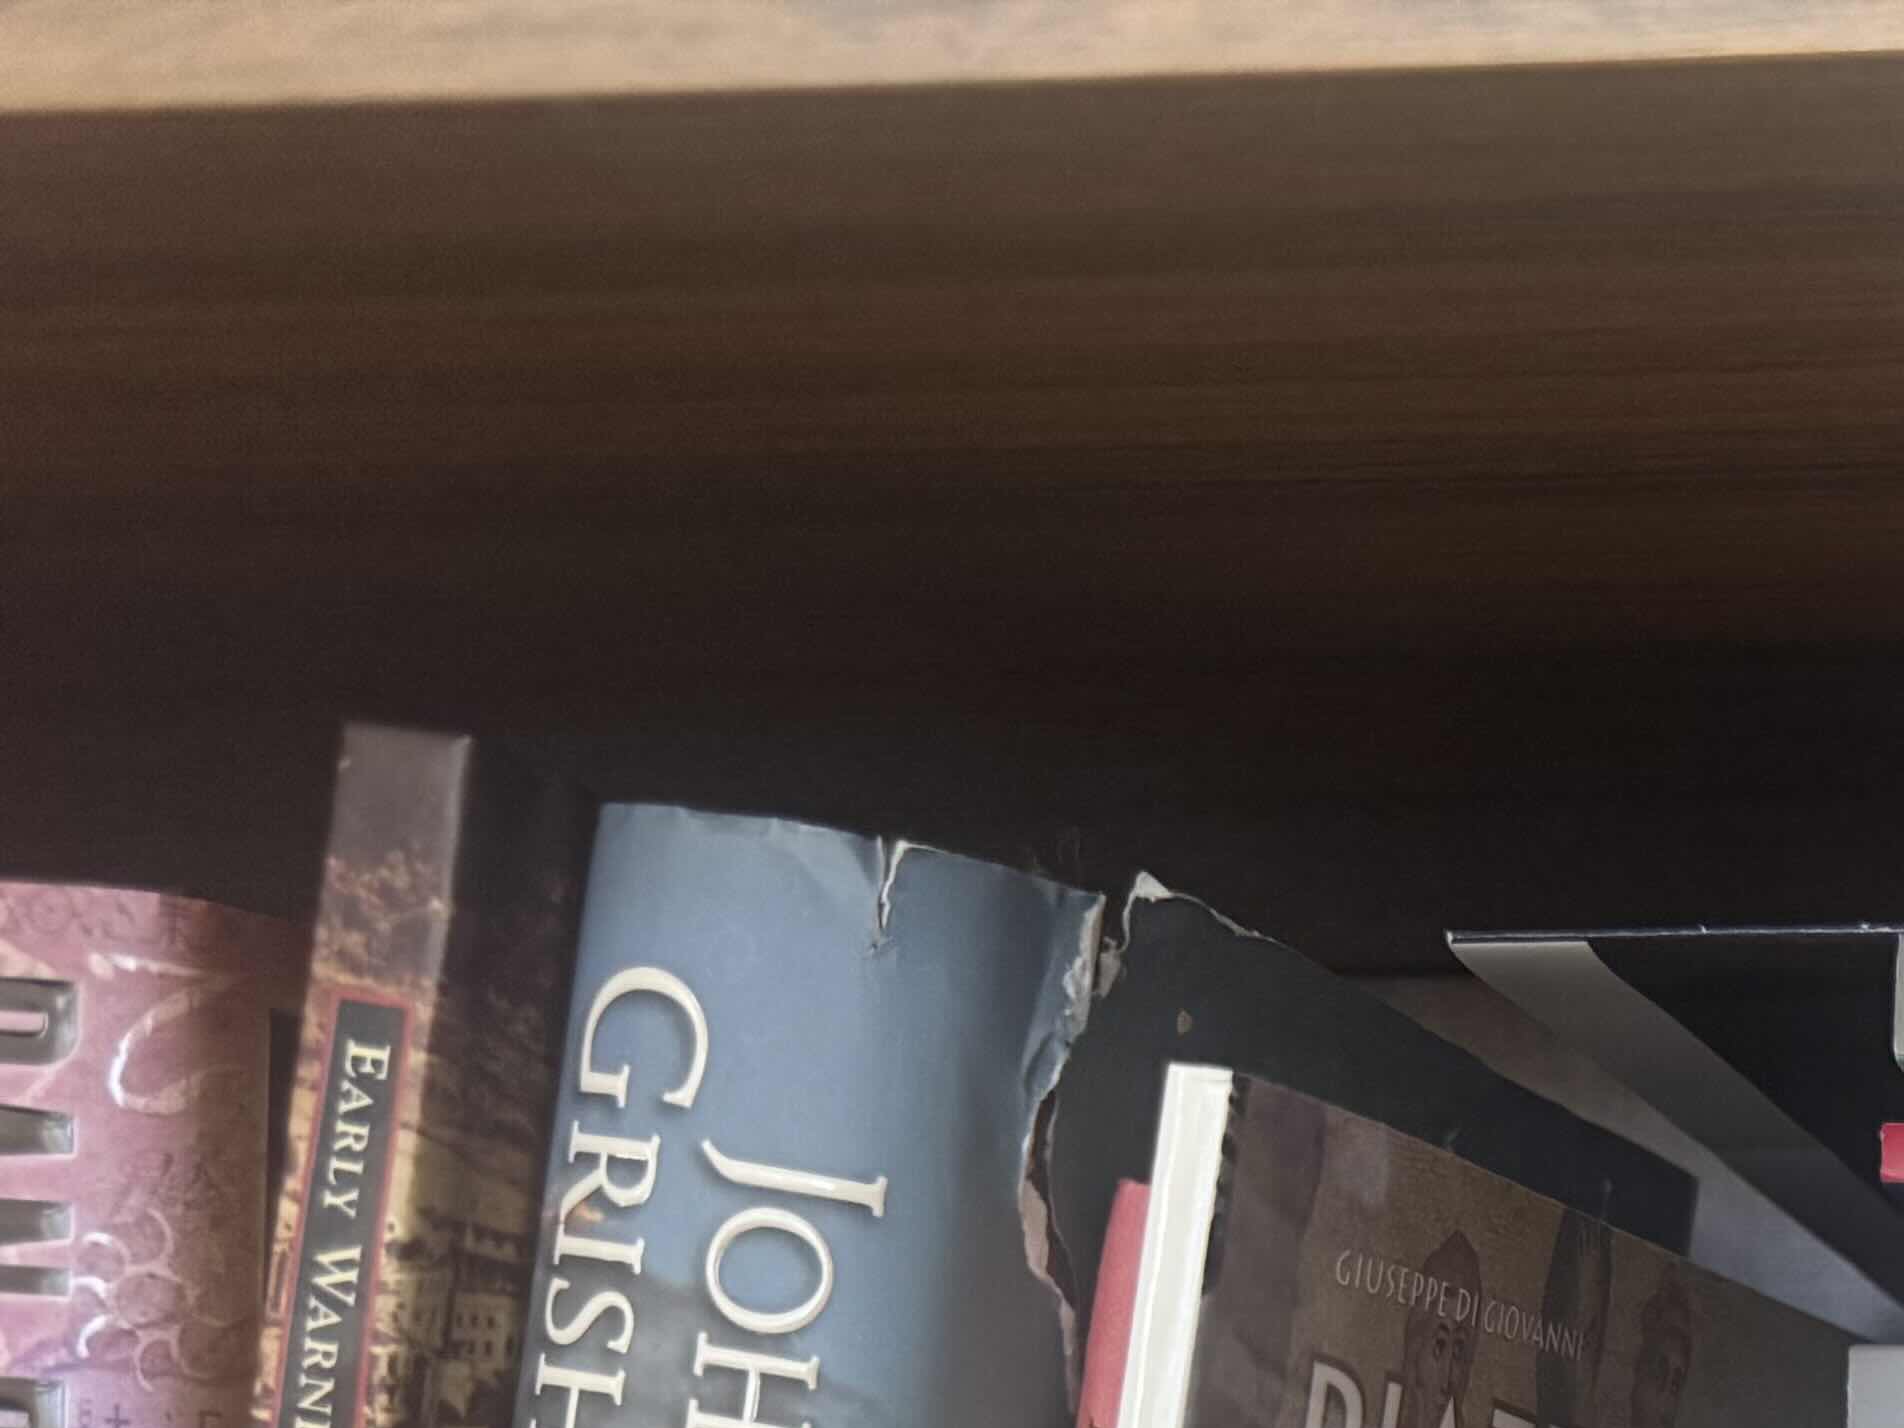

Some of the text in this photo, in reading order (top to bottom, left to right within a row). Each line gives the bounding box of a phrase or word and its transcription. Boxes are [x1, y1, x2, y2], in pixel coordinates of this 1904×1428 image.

[320, 1038, 392, 1219] EARLY
[1336, 1249, 1588, 1362] GIUSEPPE DI GIOVANNI
